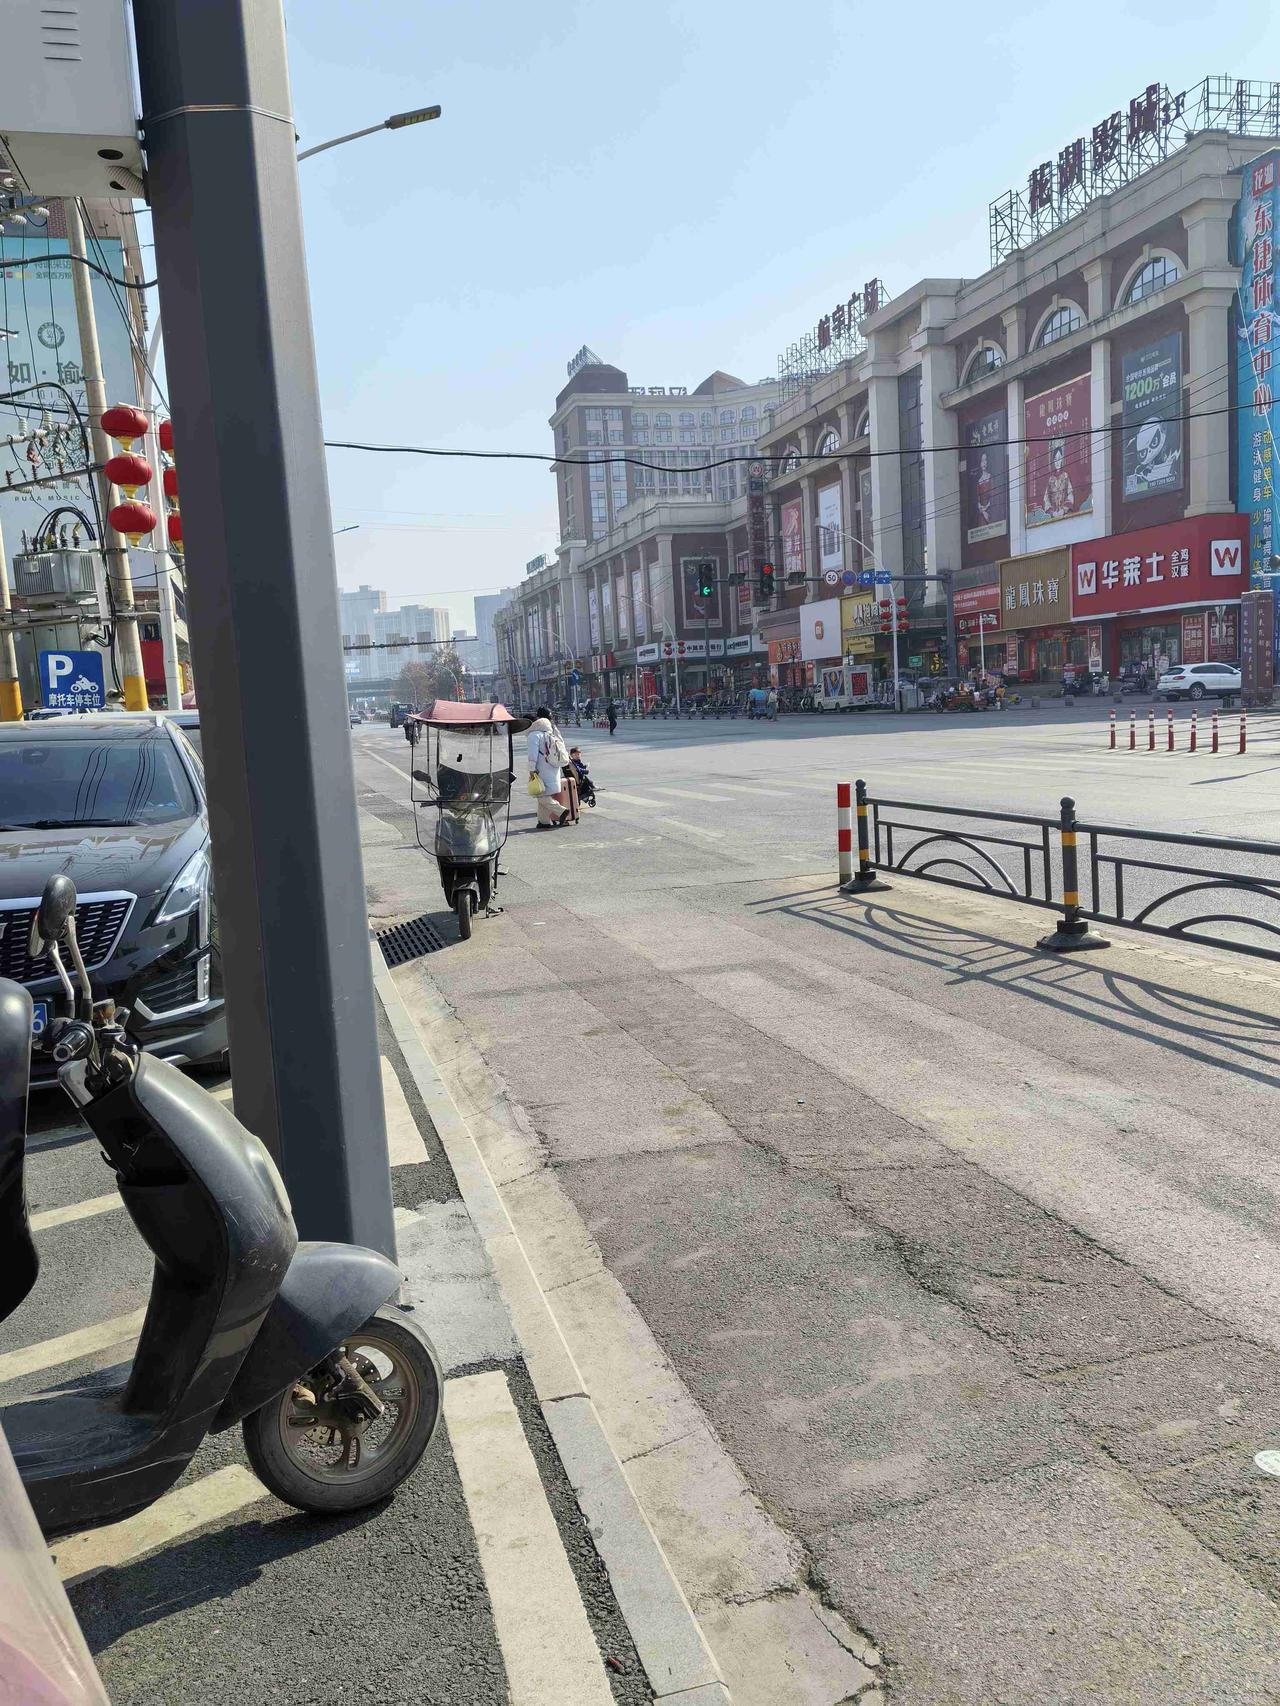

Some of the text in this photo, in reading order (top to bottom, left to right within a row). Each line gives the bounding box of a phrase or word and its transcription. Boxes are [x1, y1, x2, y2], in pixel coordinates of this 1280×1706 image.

[1253, 202, 1273, 417] 东捷体育中心
[7, 361, 88, 386] 如·瑜
[1171, 549, 1190, 562] 全鸡
[1214, 546, 1240, 569] W
[827, 574, 837, 582] 50
[1079, 552, 1165, 590] W 华莱士
[1005, 577, 1059, 611] 龍鳳珠寶
[48, 654, 74, 689] P
[49, 693, 101, 707] 摩托车停车位
